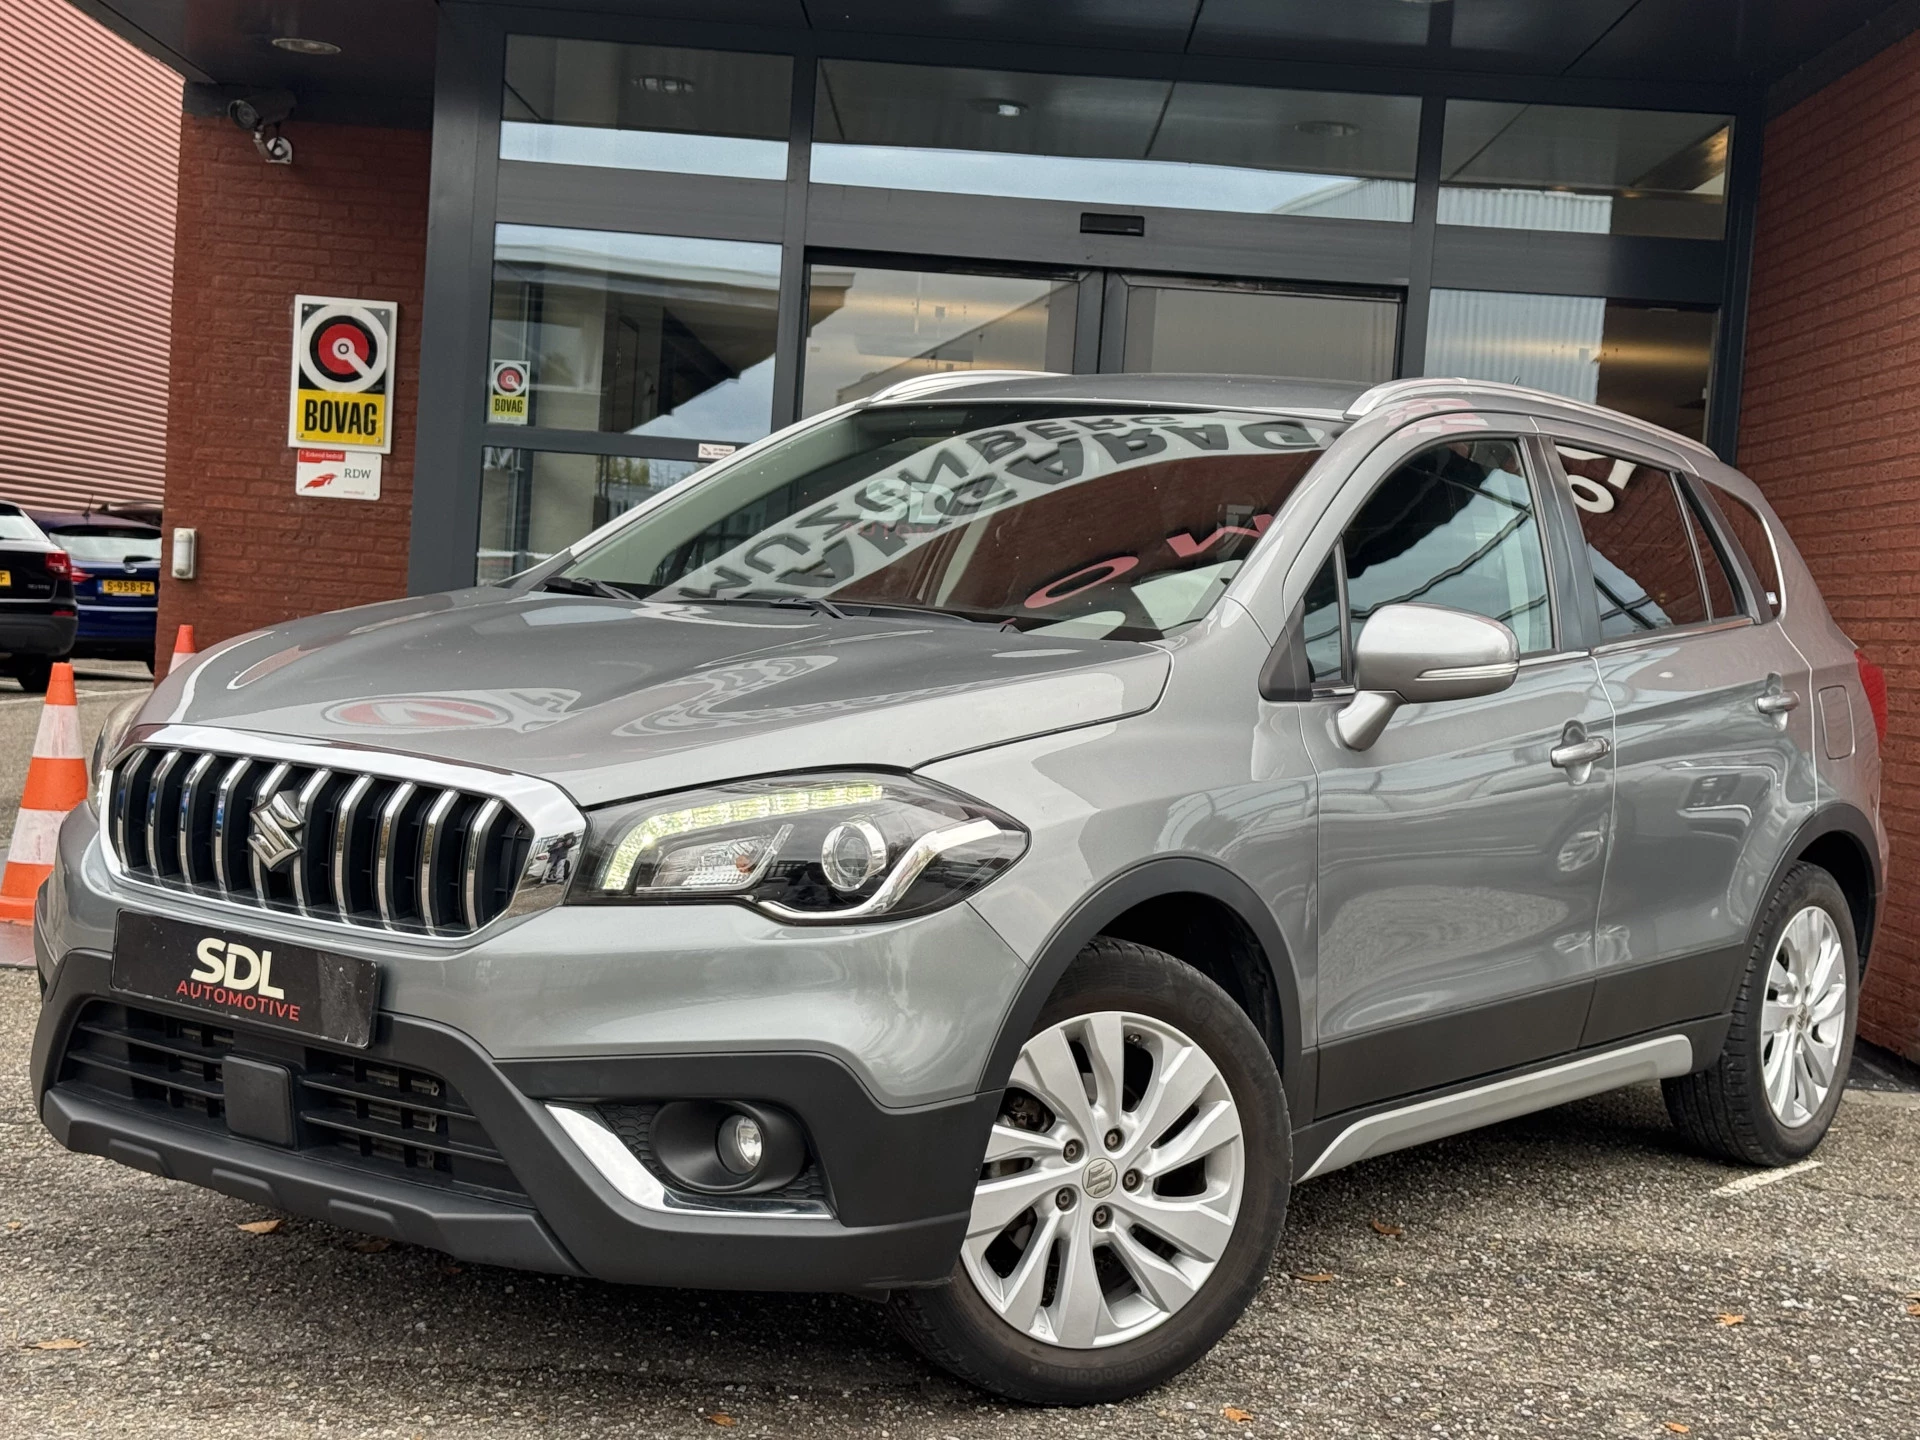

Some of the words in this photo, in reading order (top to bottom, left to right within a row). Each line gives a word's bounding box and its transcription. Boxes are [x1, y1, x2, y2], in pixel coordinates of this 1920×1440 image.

[304, 399, 377, 436] BOVAG
[494, 398, 523, 414] BOVAG
[344, 468, 371, 479] RDW
[107, 581, 152, 592] S-958-FZ
[190, 937, 285, 1000] SDL
[176, 980, 301, 1022] AUTOMOTIVE
